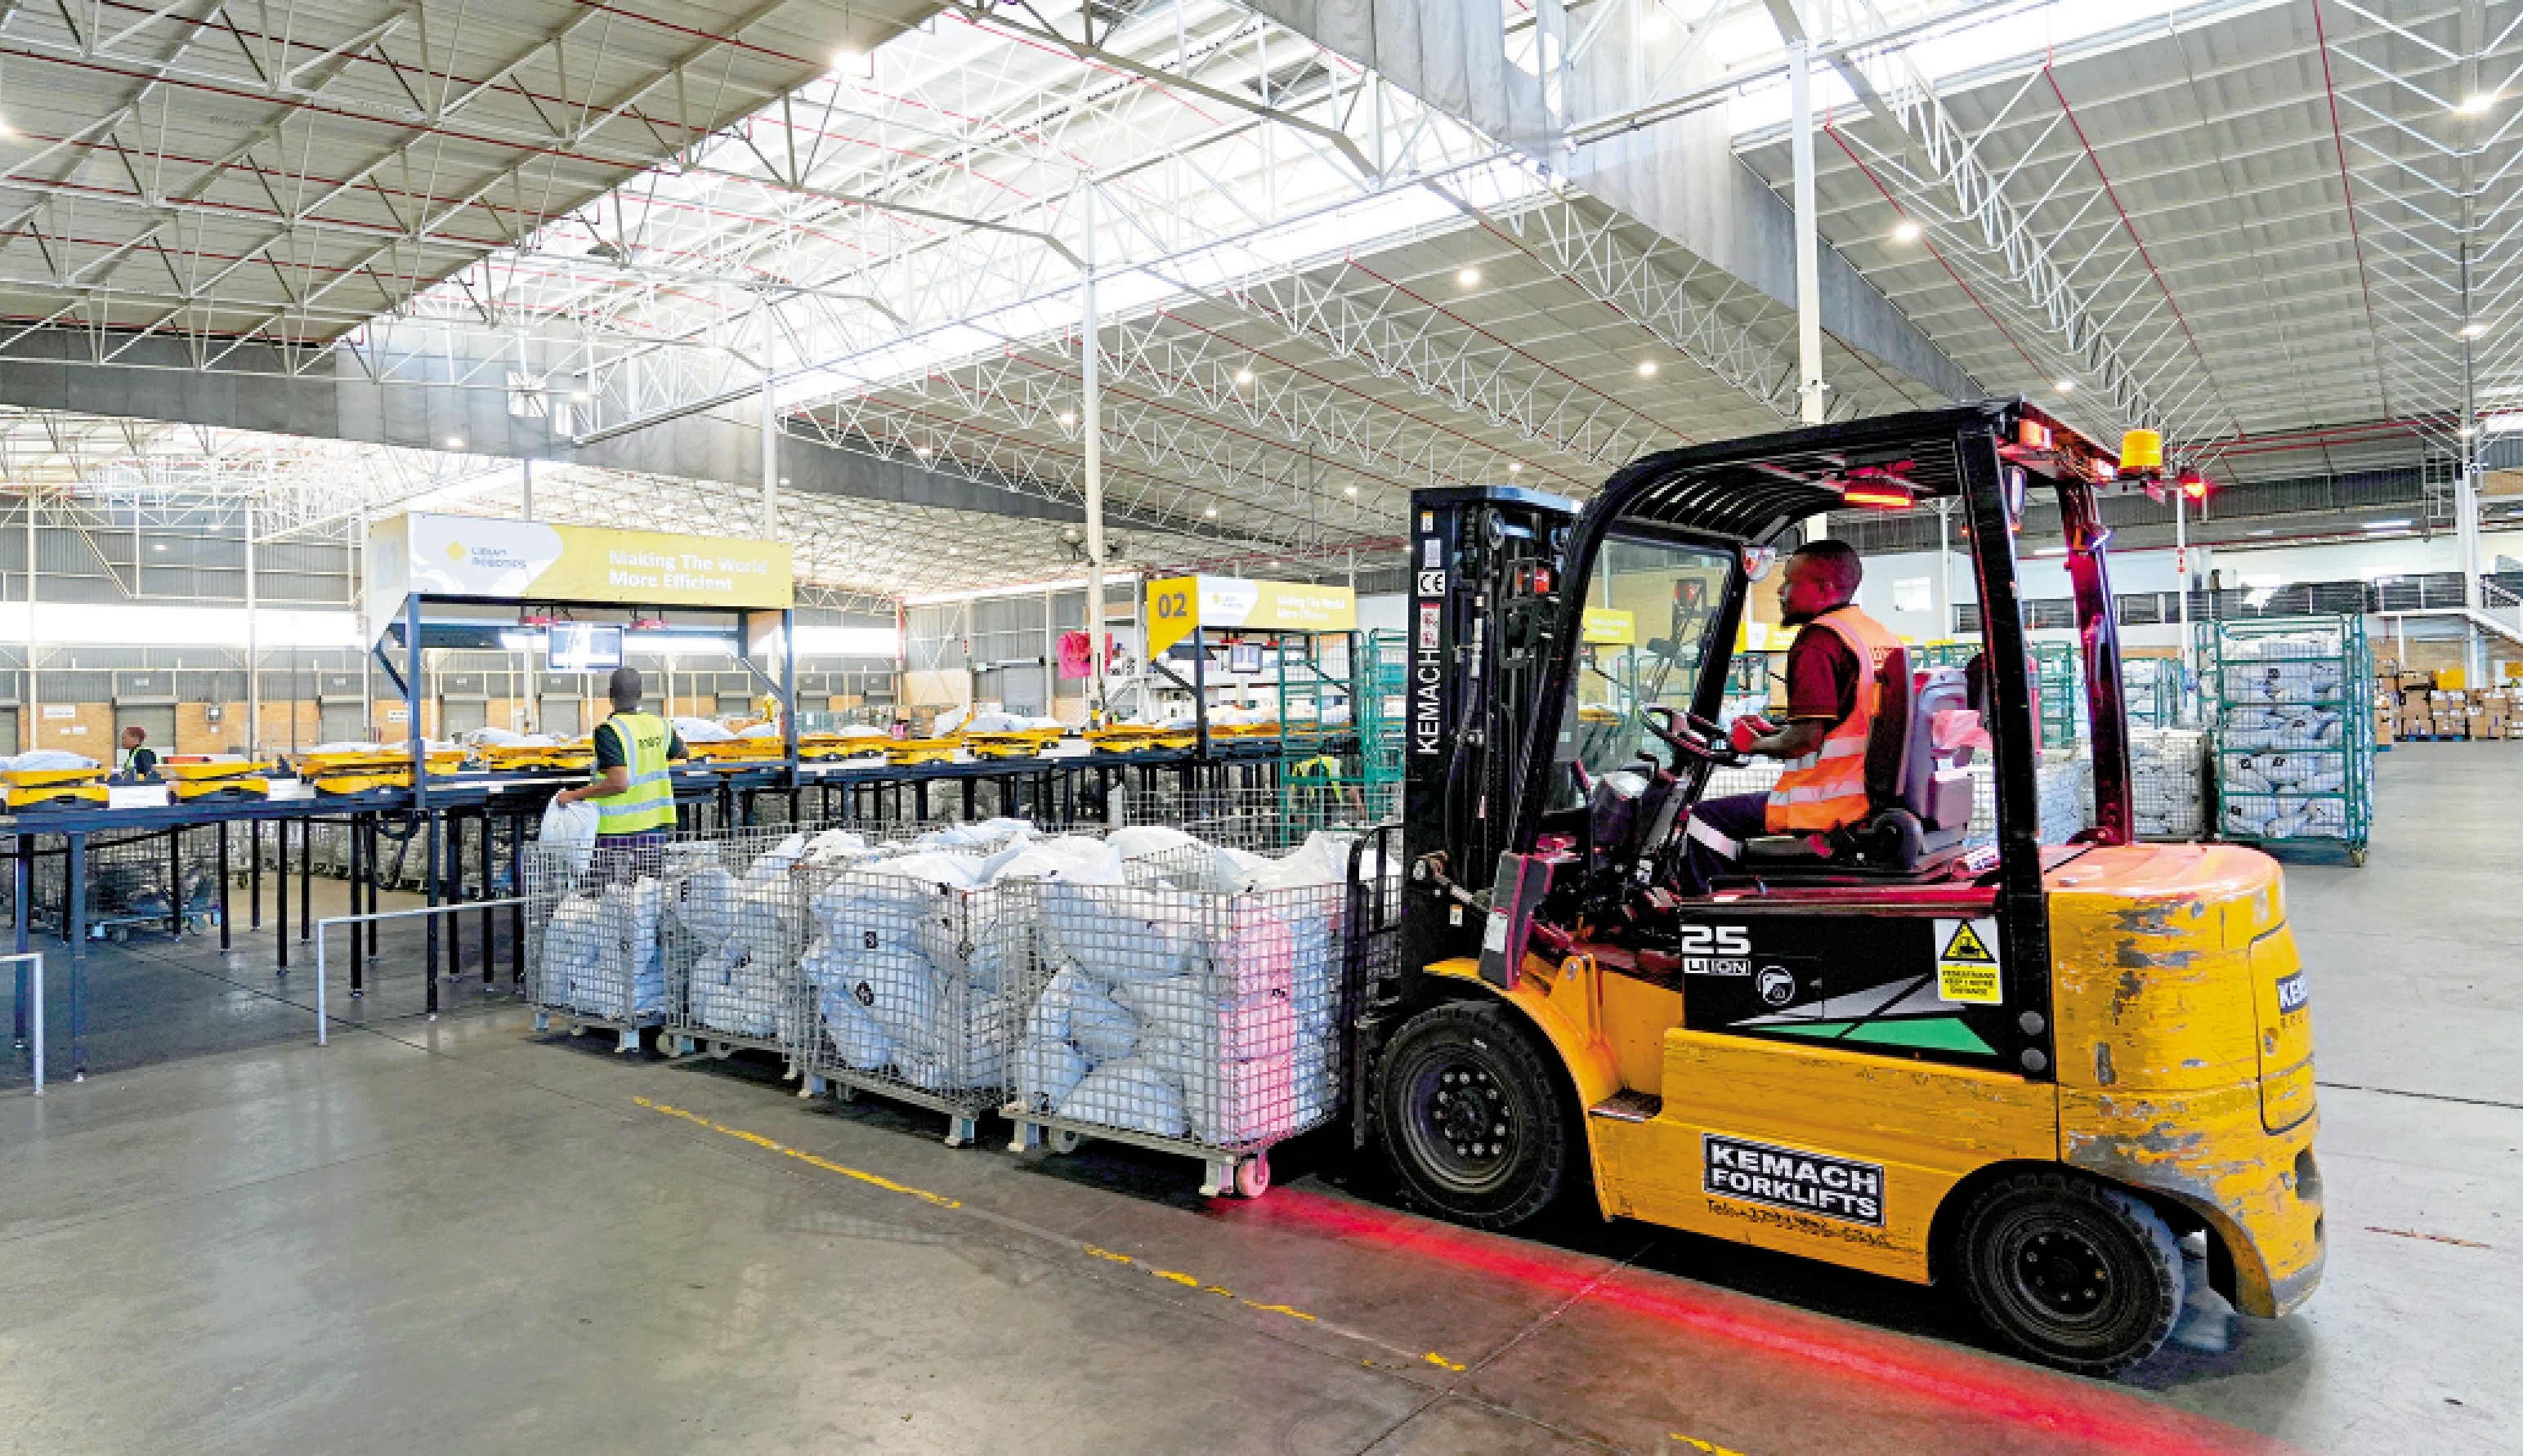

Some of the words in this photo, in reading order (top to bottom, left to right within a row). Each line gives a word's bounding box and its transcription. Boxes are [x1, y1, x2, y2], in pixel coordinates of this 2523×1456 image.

[608, 549, 676, 571] Making
[681, 554, 714, 571] The
[718, 556, 769, 575] World
[608, 570, 658, 588] More
[664, 573, 734, 592] Efficient
[1158, 592, 1188, 619] 02
[1417, 650, 1441, 754] KEMACH
[1680, 923, 1751, 955] 25
[1711, 1145, 1877, 1195] KEMACH
[1713, 1168, 1877, 1216] FORKLIFTS
